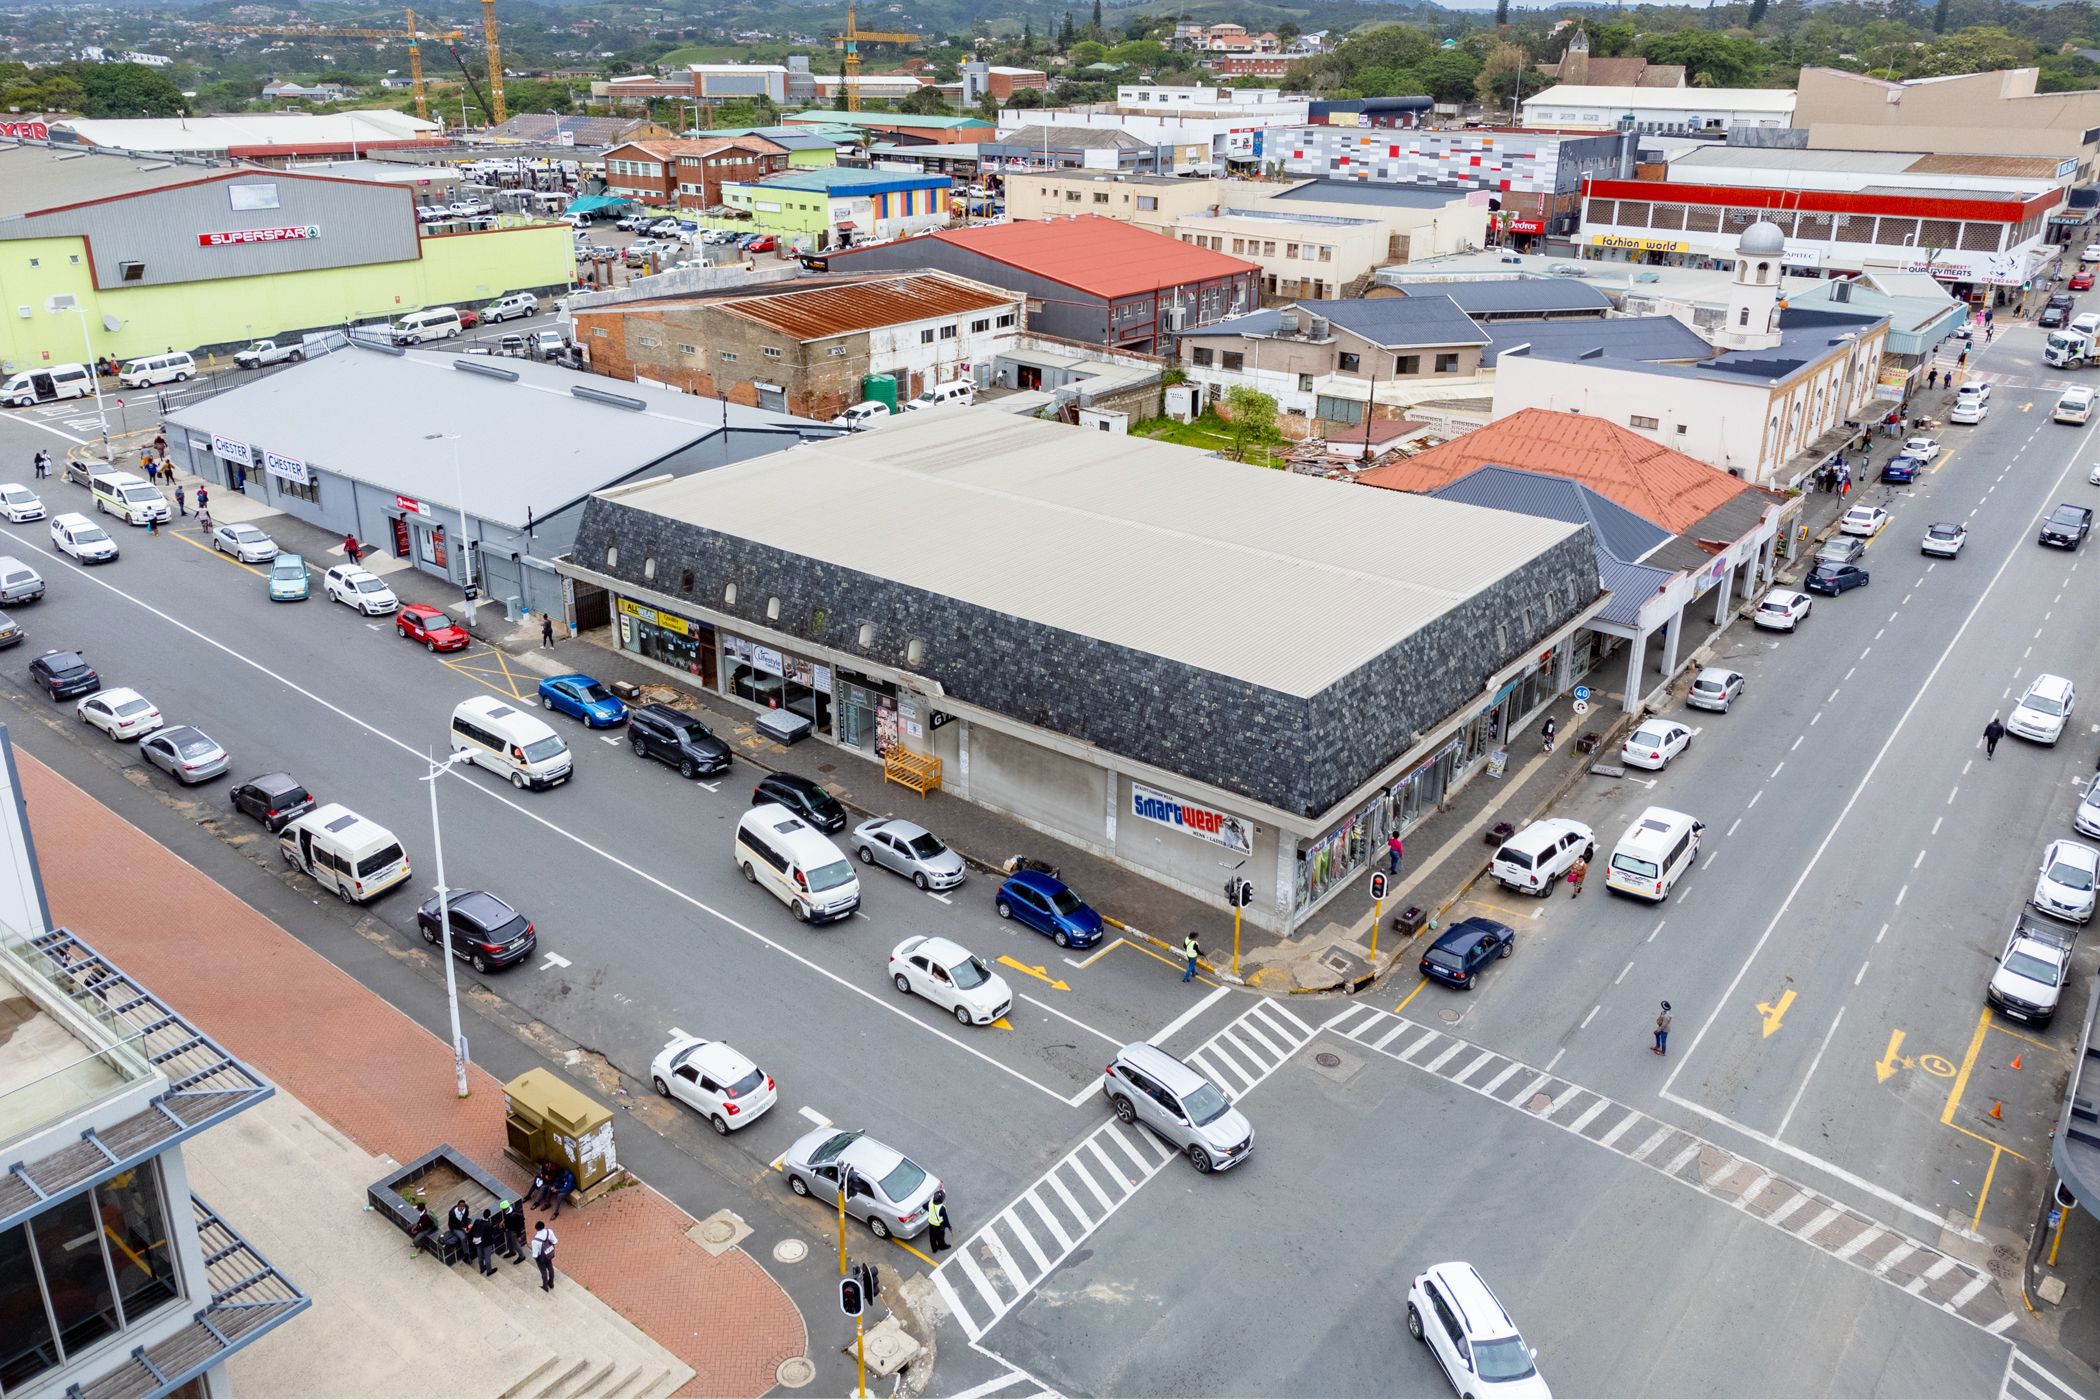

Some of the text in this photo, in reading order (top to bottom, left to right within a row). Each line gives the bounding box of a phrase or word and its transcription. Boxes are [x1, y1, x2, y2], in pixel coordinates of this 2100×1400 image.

[210, 228, 305, 245] SUPERSPAR
[1602, 236, 1677, 251] fashion world
[1944, 268, 1972, 277] MEATS
[215, 438, 247, 460] CHESTER
[268, 455, 303, 477] CHESTER
[1576, 689, 1588, 698] 40
